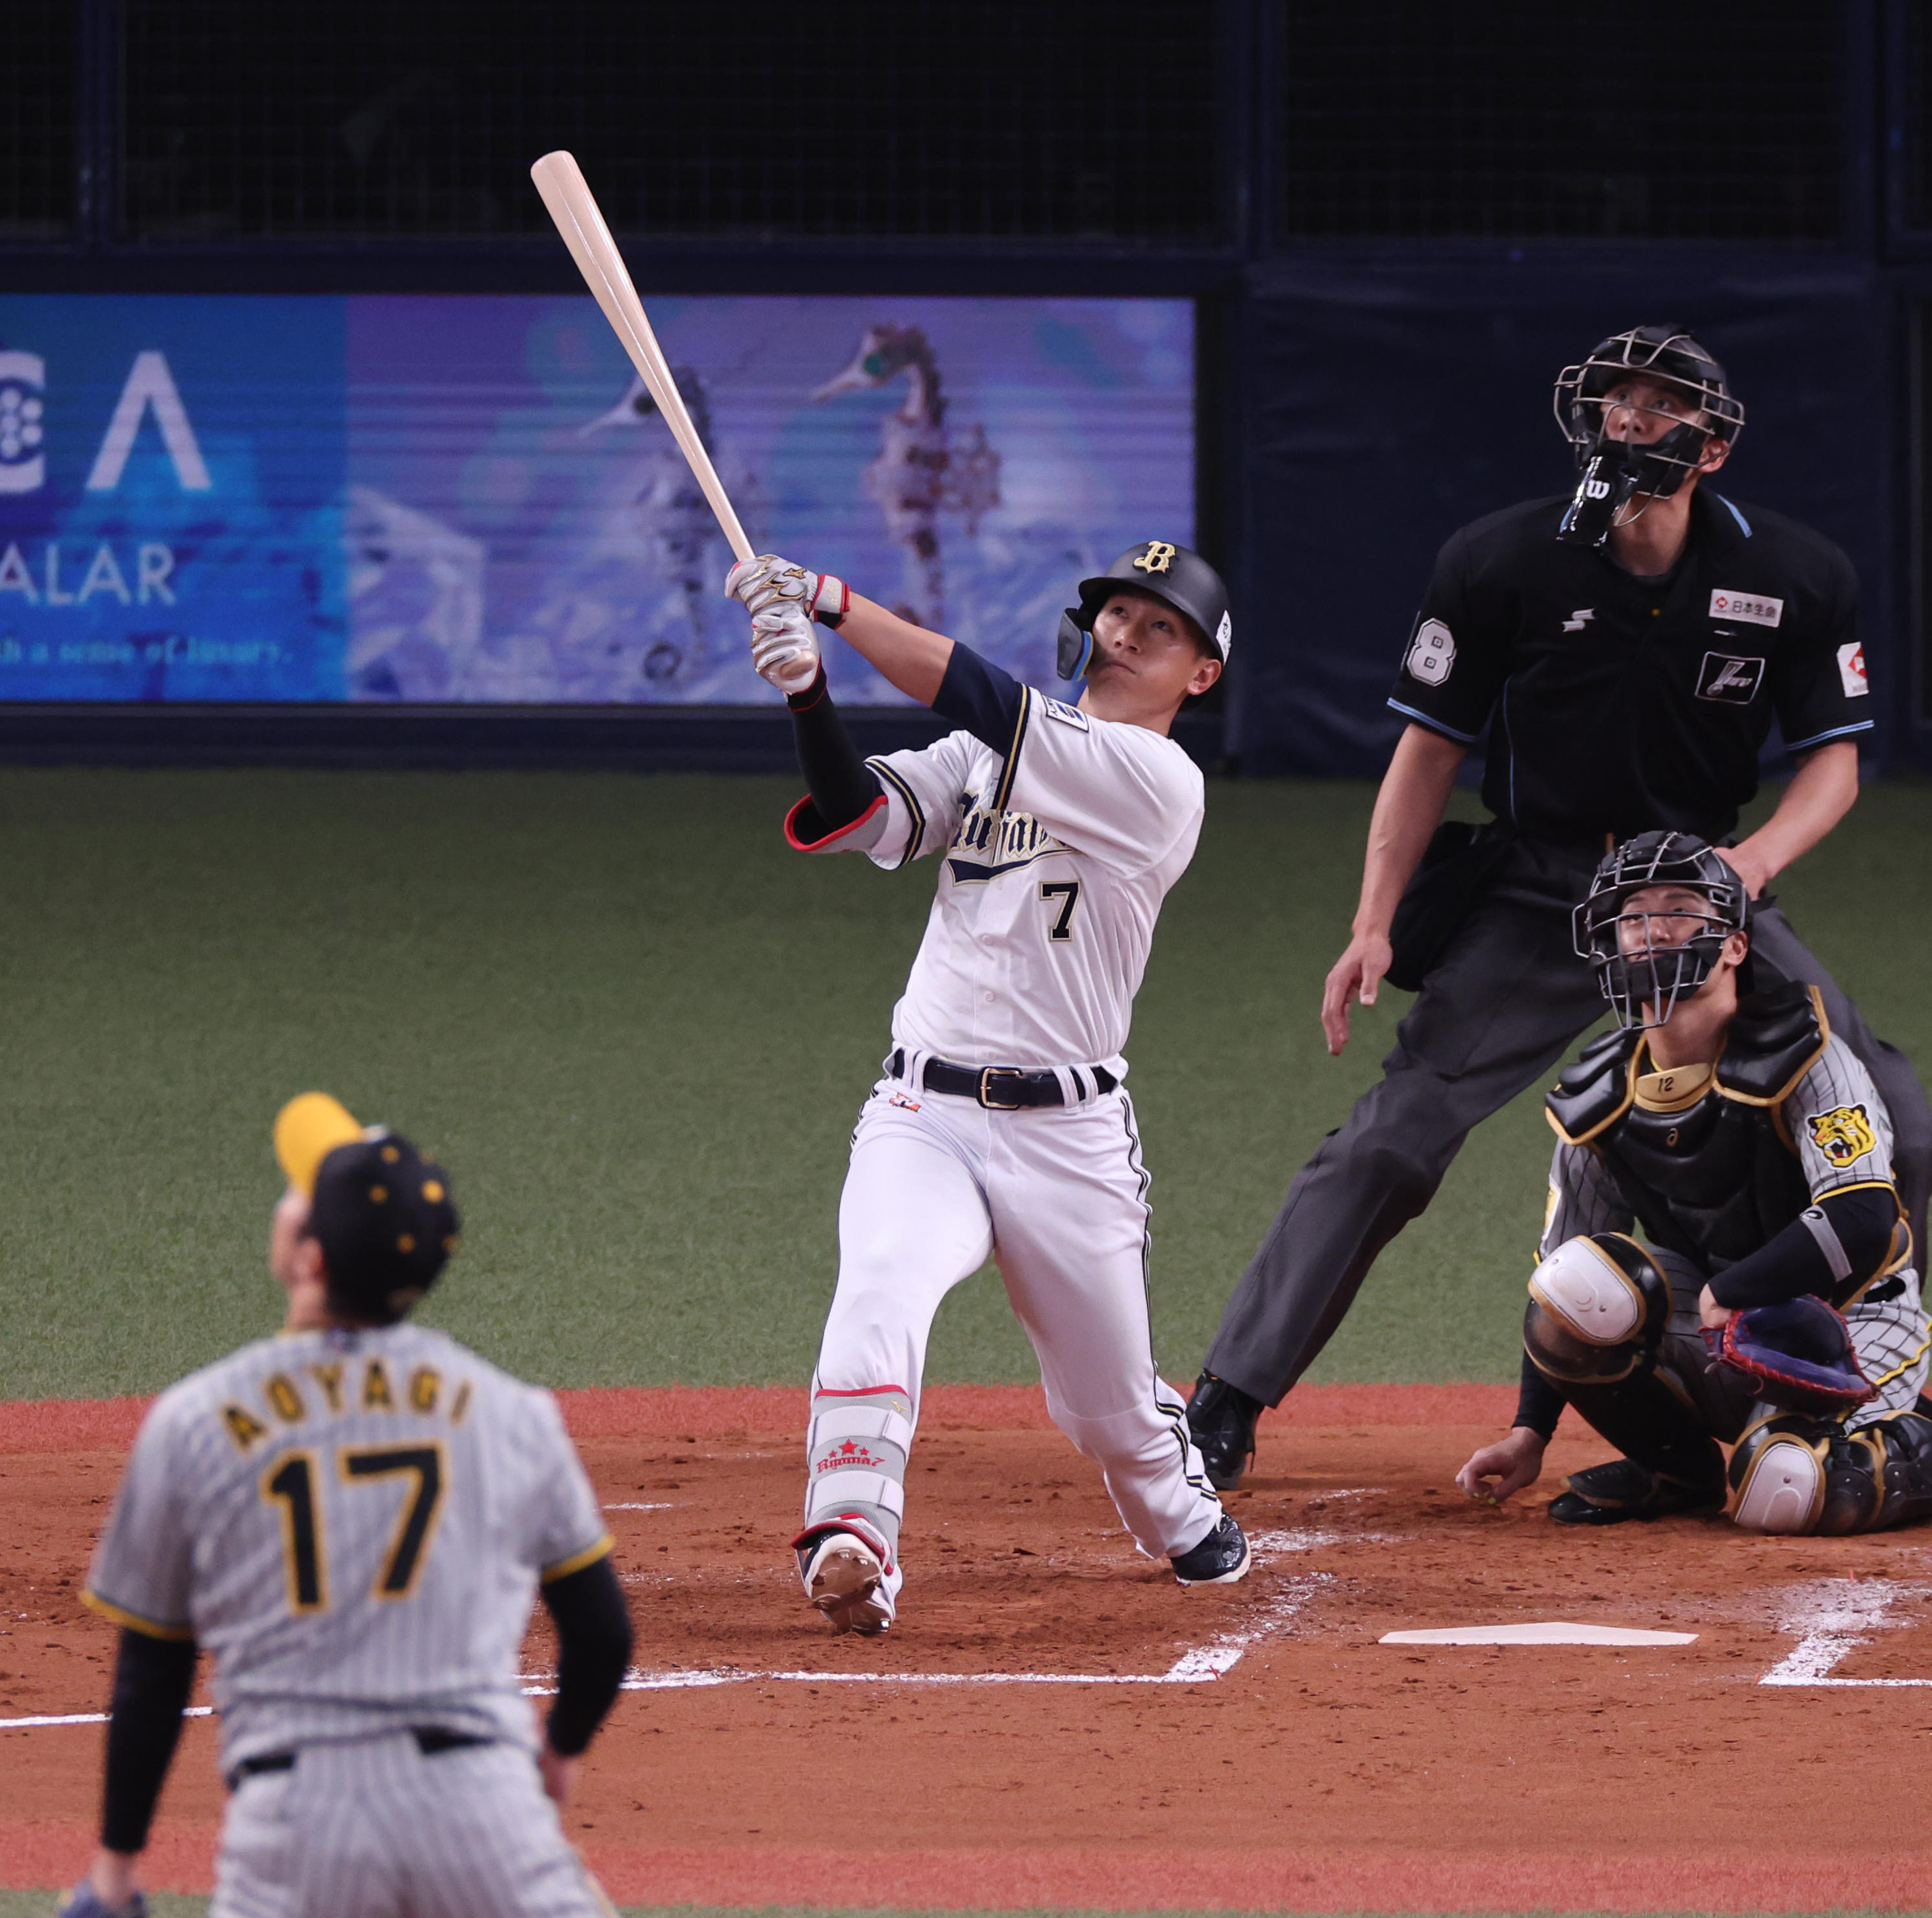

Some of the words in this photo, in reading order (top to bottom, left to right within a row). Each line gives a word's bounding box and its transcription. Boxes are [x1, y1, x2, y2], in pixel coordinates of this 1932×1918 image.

[0, 542, 176, 605] ALAR
[1133, 540, 1175, 574] B
[1406, 617, 1457, 687] 8
[1038, 878, 1081, 942] 7
[1658, 1076, 1674, 1093] 12
[221, 1356, 472, 1452] AOYAGI
[260, 1438, 447, 1615] 17
